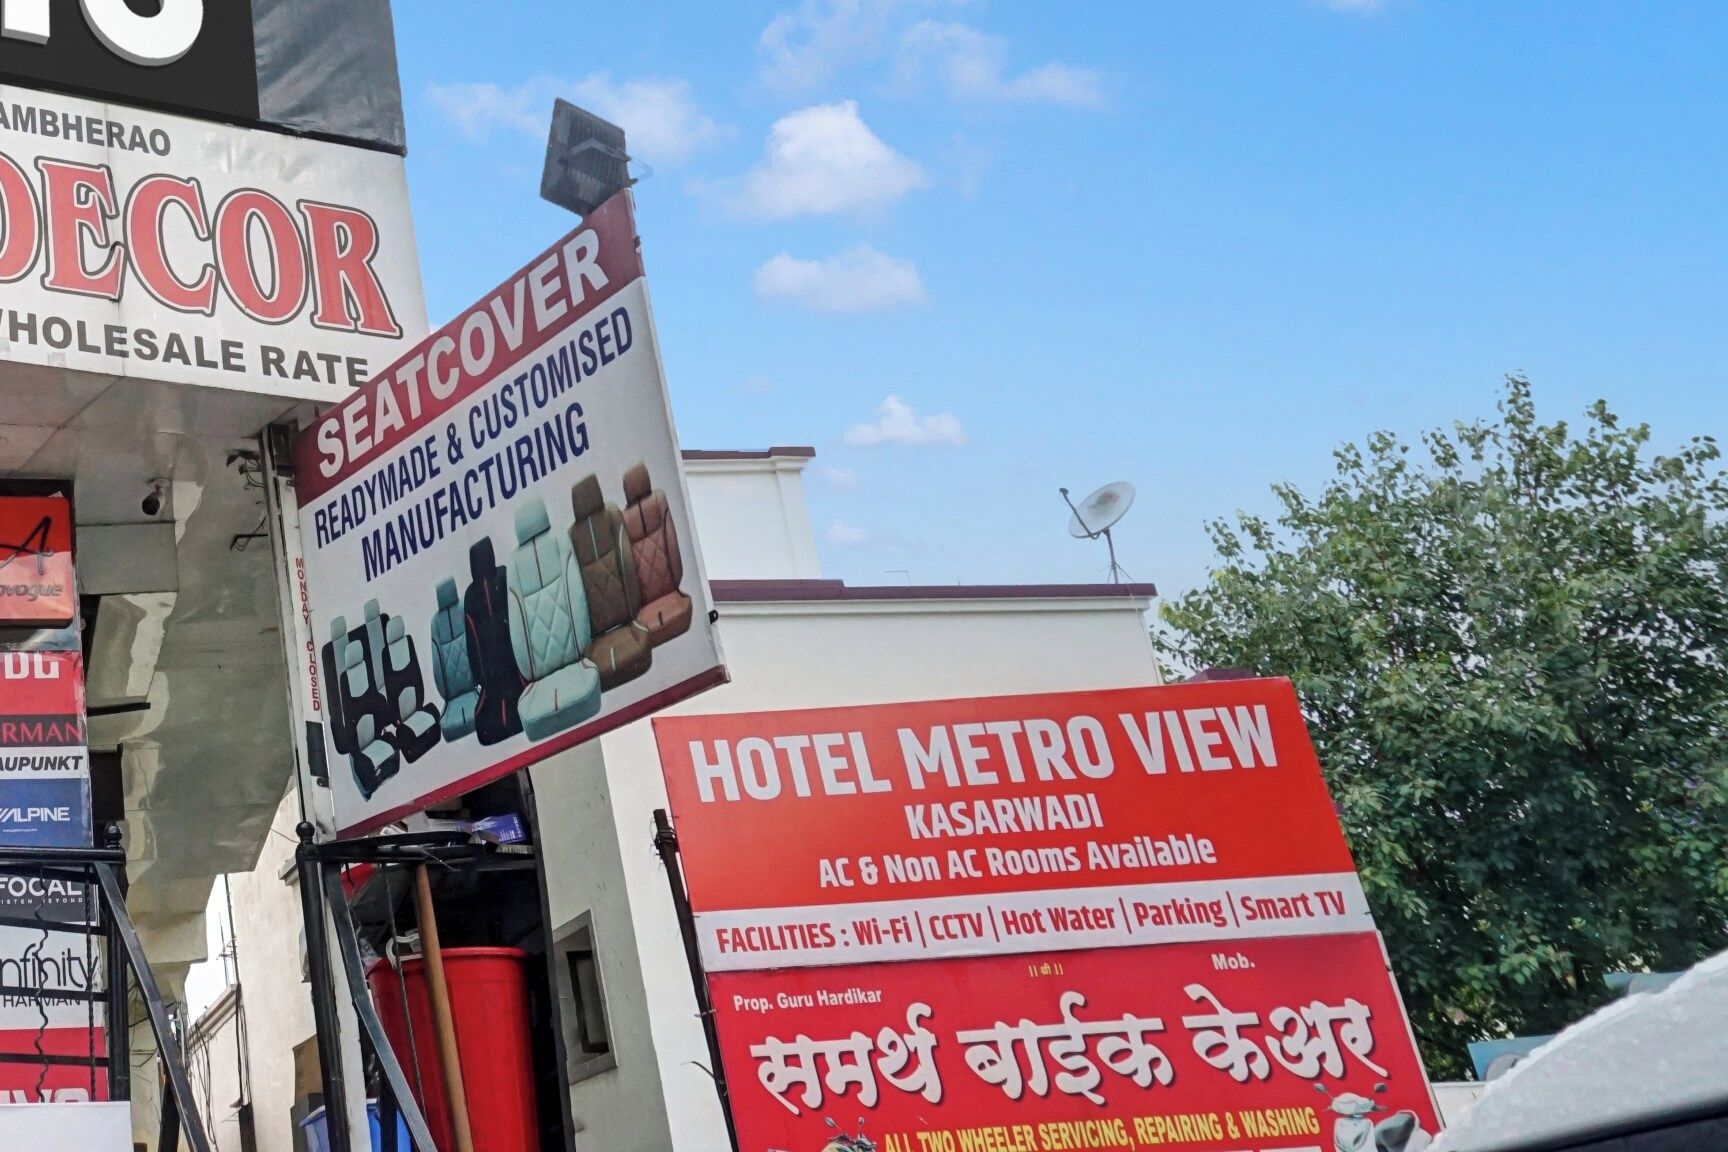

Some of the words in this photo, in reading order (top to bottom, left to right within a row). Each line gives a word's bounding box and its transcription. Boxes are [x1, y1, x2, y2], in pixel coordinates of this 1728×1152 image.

[261, 346, 369, 388] RATE
[317, 228, 610, 479] SEATCOVER
[314, 435, 441, 550] READYMADE
[446, 422, 464, 466] &
[468, 306, 633, 450] CUSTOMISED
[361, 402, 590, 583] MANUFACTURING
[295, 557, 311, 626] MONDAY
[306, 640, 322, 711] CLOSED
[688, 731, 892, 803] HOTEL
[896, 715, 1116, 790] METRO
[1118, 704, 1278, 776] VIEW
[4, 807, 70, 822] ALPINE
[904, 793, 1104, 840] KASARWADI
[819, 857, 854, 887] AC
[861, 854, 880, 884] &
[883, 852, 941, 883] Non
[948, 849, 977, 879] AC
[985, 844, 1082, 877] Rooms
[1087, 833, 1218, 871] Available
[716, 922, 836, 953] FACILITIES
[852, 915, 913, 946] Wi-Fi
[929, 912, 985, 940] CCTV
[1001, 909, 1046, 935] Hot
[1048, 905, 1116, 933] Water
[1133, 897, 1228, 928] Parking
[1240, 892, 1314, 921] Smart
[1314, 890, 1346, 917] TV
[1211, 952, 1256, 971] Mob.
[733, 994, 774, 1013] Prop.
[776, 993, 814, 1009] Guru
[817, 988, 882, 1006] Hardikar
[749, 1002, 942, 1115] समर्थ
[956, 991, 1174, 1106] बाईक
[1181, 983, 1389, 1083] केअर
[884, 1134, 910, 1152] ALL
[917, 1131, 955, 1152] TWO
[956, 1123, 1038, 1152] WHEELER
[1037, 1118, 1136, 1151] SERVICING,
[1134, 1112, 1224, 1143] REPAIRING
[1226, 1110, 1241, 1138] &
[1241, 1106, 1322, 1137] WASHING
